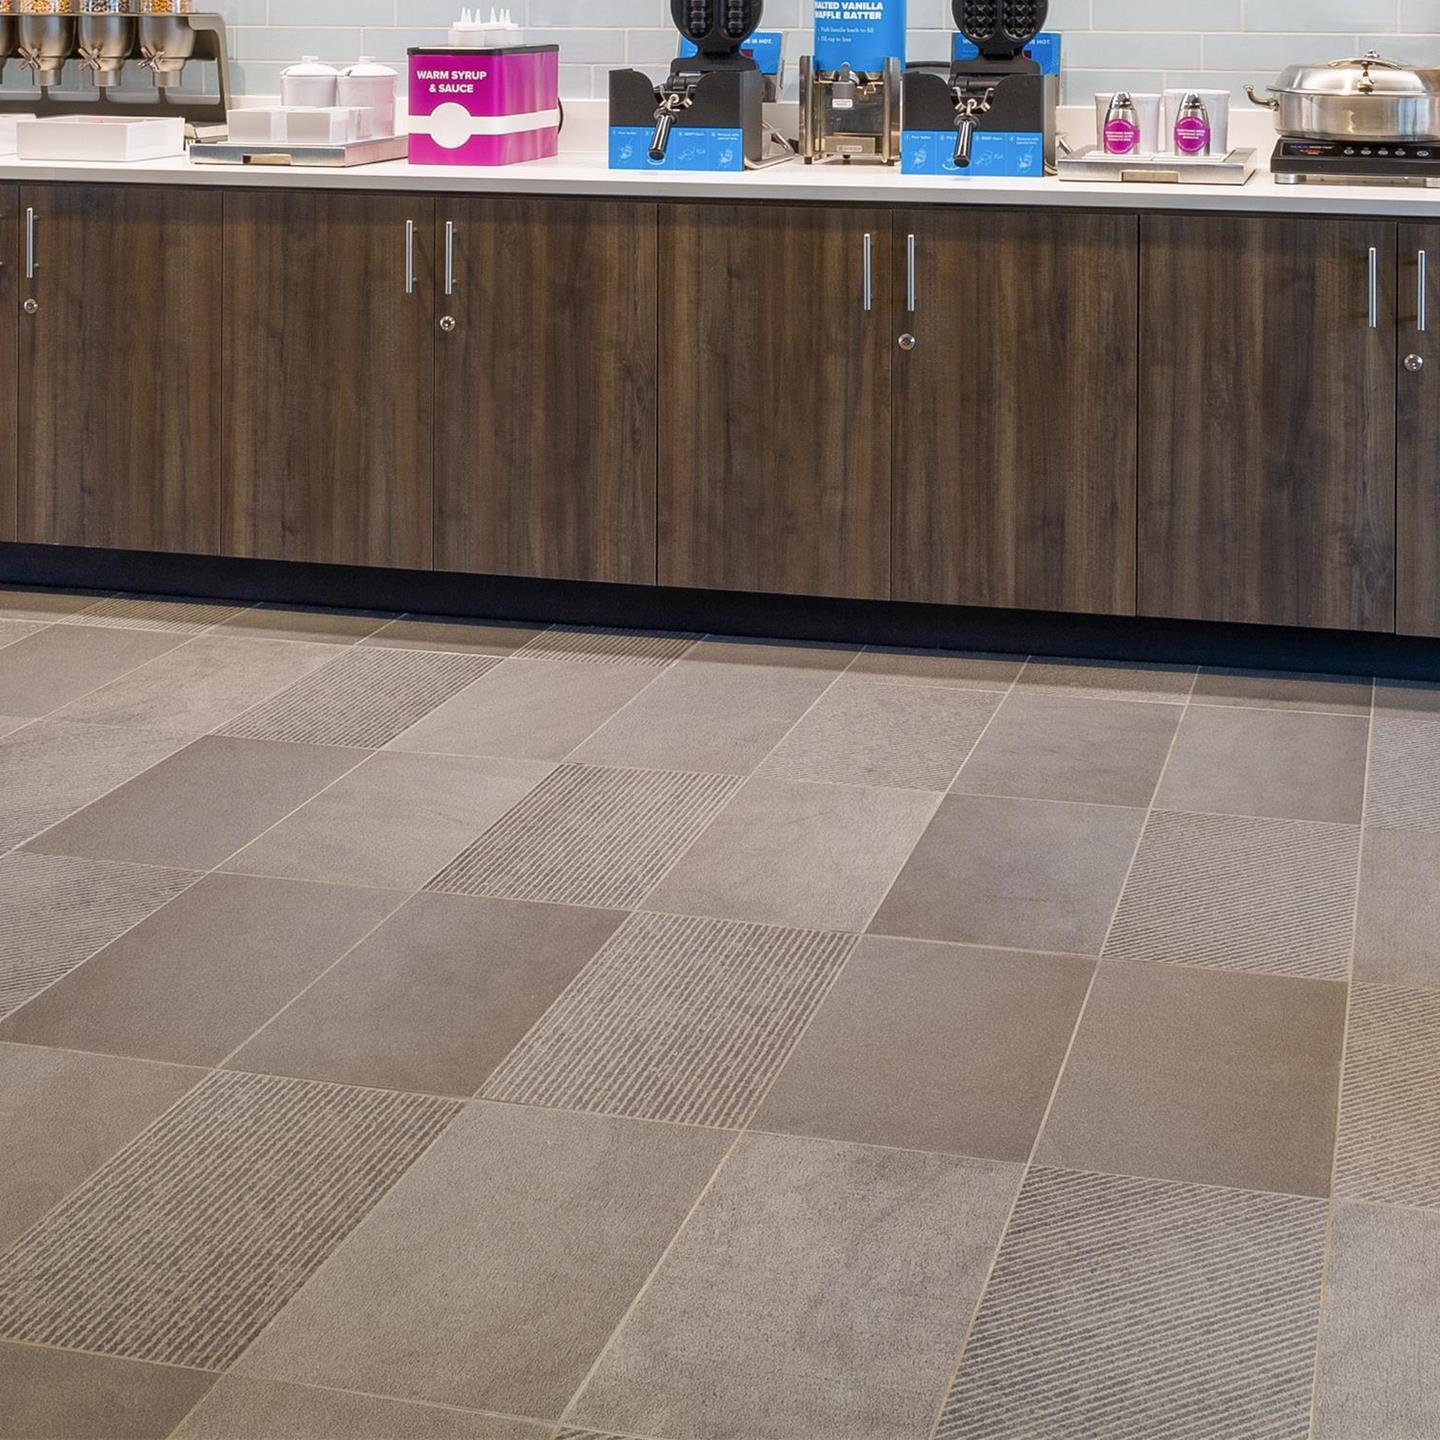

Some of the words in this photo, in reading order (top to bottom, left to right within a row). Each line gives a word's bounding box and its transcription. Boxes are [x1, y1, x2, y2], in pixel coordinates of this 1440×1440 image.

[840, 1, 884, 10] VANILLA
[843, 11, 882, 20] BATTER
[416, 70, 449, 80] WARM
[451, 70, 487, 80] SYRUP
[428, 83, 437, 93] &
[438, 83, 474, 93] SAUCE
